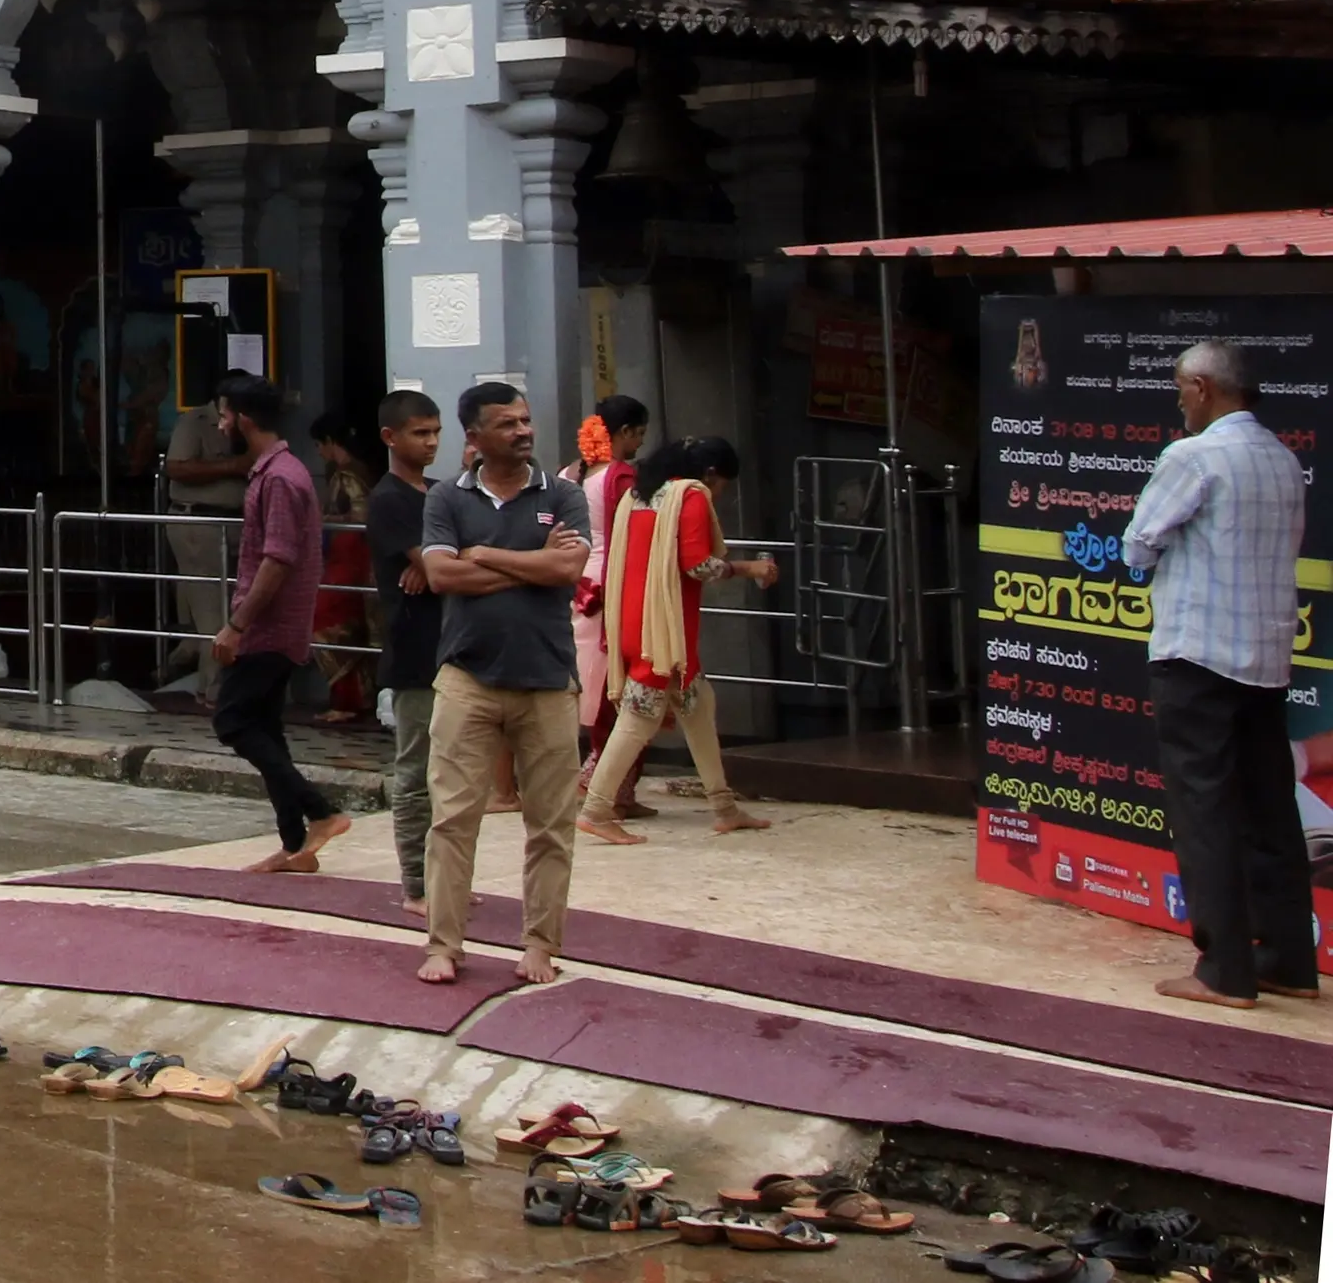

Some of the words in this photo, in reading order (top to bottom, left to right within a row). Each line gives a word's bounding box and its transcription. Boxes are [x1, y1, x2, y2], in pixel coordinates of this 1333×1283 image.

[991, 416, 1044, 436] ದಿನಾಂಕ
[1123, 422, 1161, 442] ರಿಂದ
[999, 446, 1064, 467] ಪರ್ಯಾಯ
[1008, 480, 1030, 508] ಶ್ರೀ
[1035, 482, 1140, 519] ಶ್ರೀವಿದ್ಯಾಧೀಶ
[993, 570, 1152, 628] ಭಾಗವತ
[986, 637, 1031, 661] ಪ್ರವಚನ
[1036, 646, 1089, 670] ಸಮಯ
[1024, 679, 1056, 699] 7.30
[1061, 684, 1096, 707] ರಿಂದ
[1101, 693, 1136, 714] 8.30
[986, 703, 1052, 741] ಪ್ರವಚನಸ್ಥಳ
[989, 813, 1002, 824] For
[1002, 816, 1016, 827] Full
[1017, 819, 1029, 830] HD
[989, 825, 1006, 838] Live
[1006, 827, 1038, 844] telecast
[1094, 862, 1129, 878] SUBSCRIBE
[1083, 878, 1121, 900] Palimaru
[1123, 889, 1150, 907] Matha
